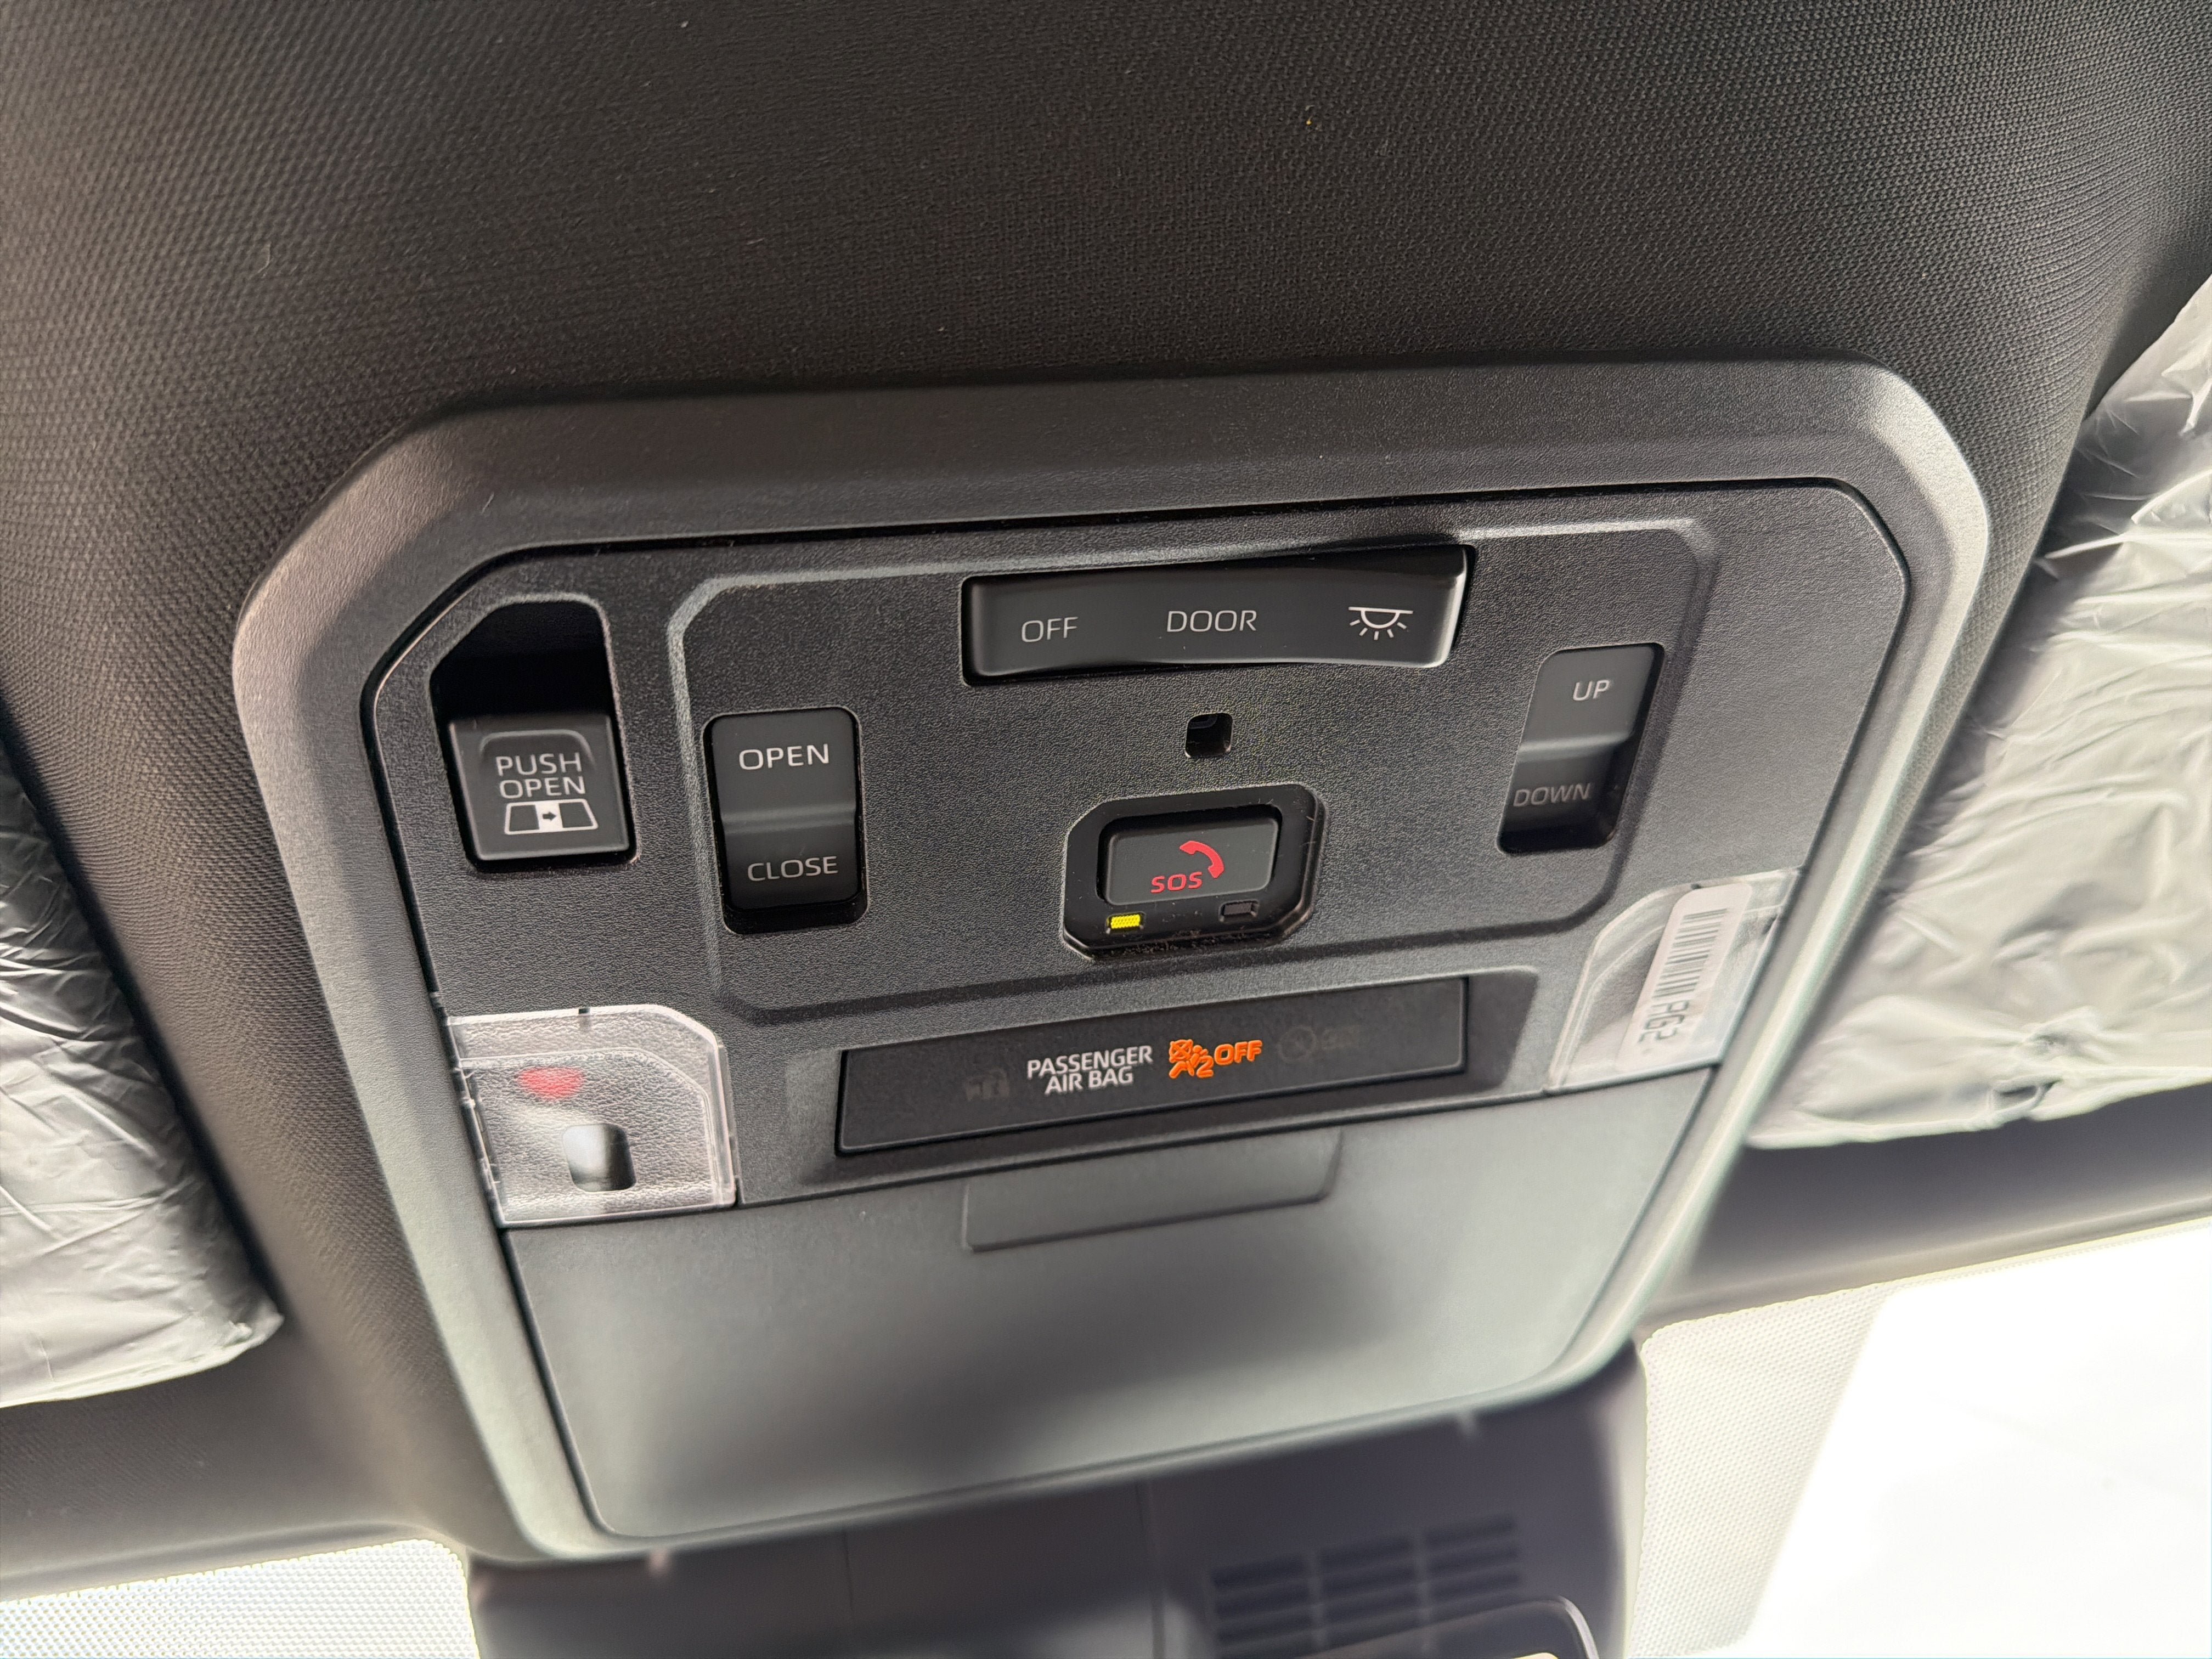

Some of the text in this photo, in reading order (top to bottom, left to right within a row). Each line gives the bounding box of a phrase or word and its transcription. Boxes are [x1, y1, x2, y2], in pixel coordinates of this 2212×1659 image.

[1022, 617, 1078, 642] OFF
[1167, 610, 1257, 633] DOOR
[1573, 680, 1611, 702] UP
[495, 753, 582, 776] PUSH
[739, 743, 830, 770] OPEN
[499, 776, 586, 799] OPEN
[1513, 783, 1592, 807] DOWN
[748, 856, 838, 881] CLOSE
[1150, 871, 1203, 893] SOS
[1027, 1045, 1153, 1079] PASSENGER
[1214, 1040, 1262, 1066] OFF
[1045, 1066, 1134, 1095] AIR BAG
